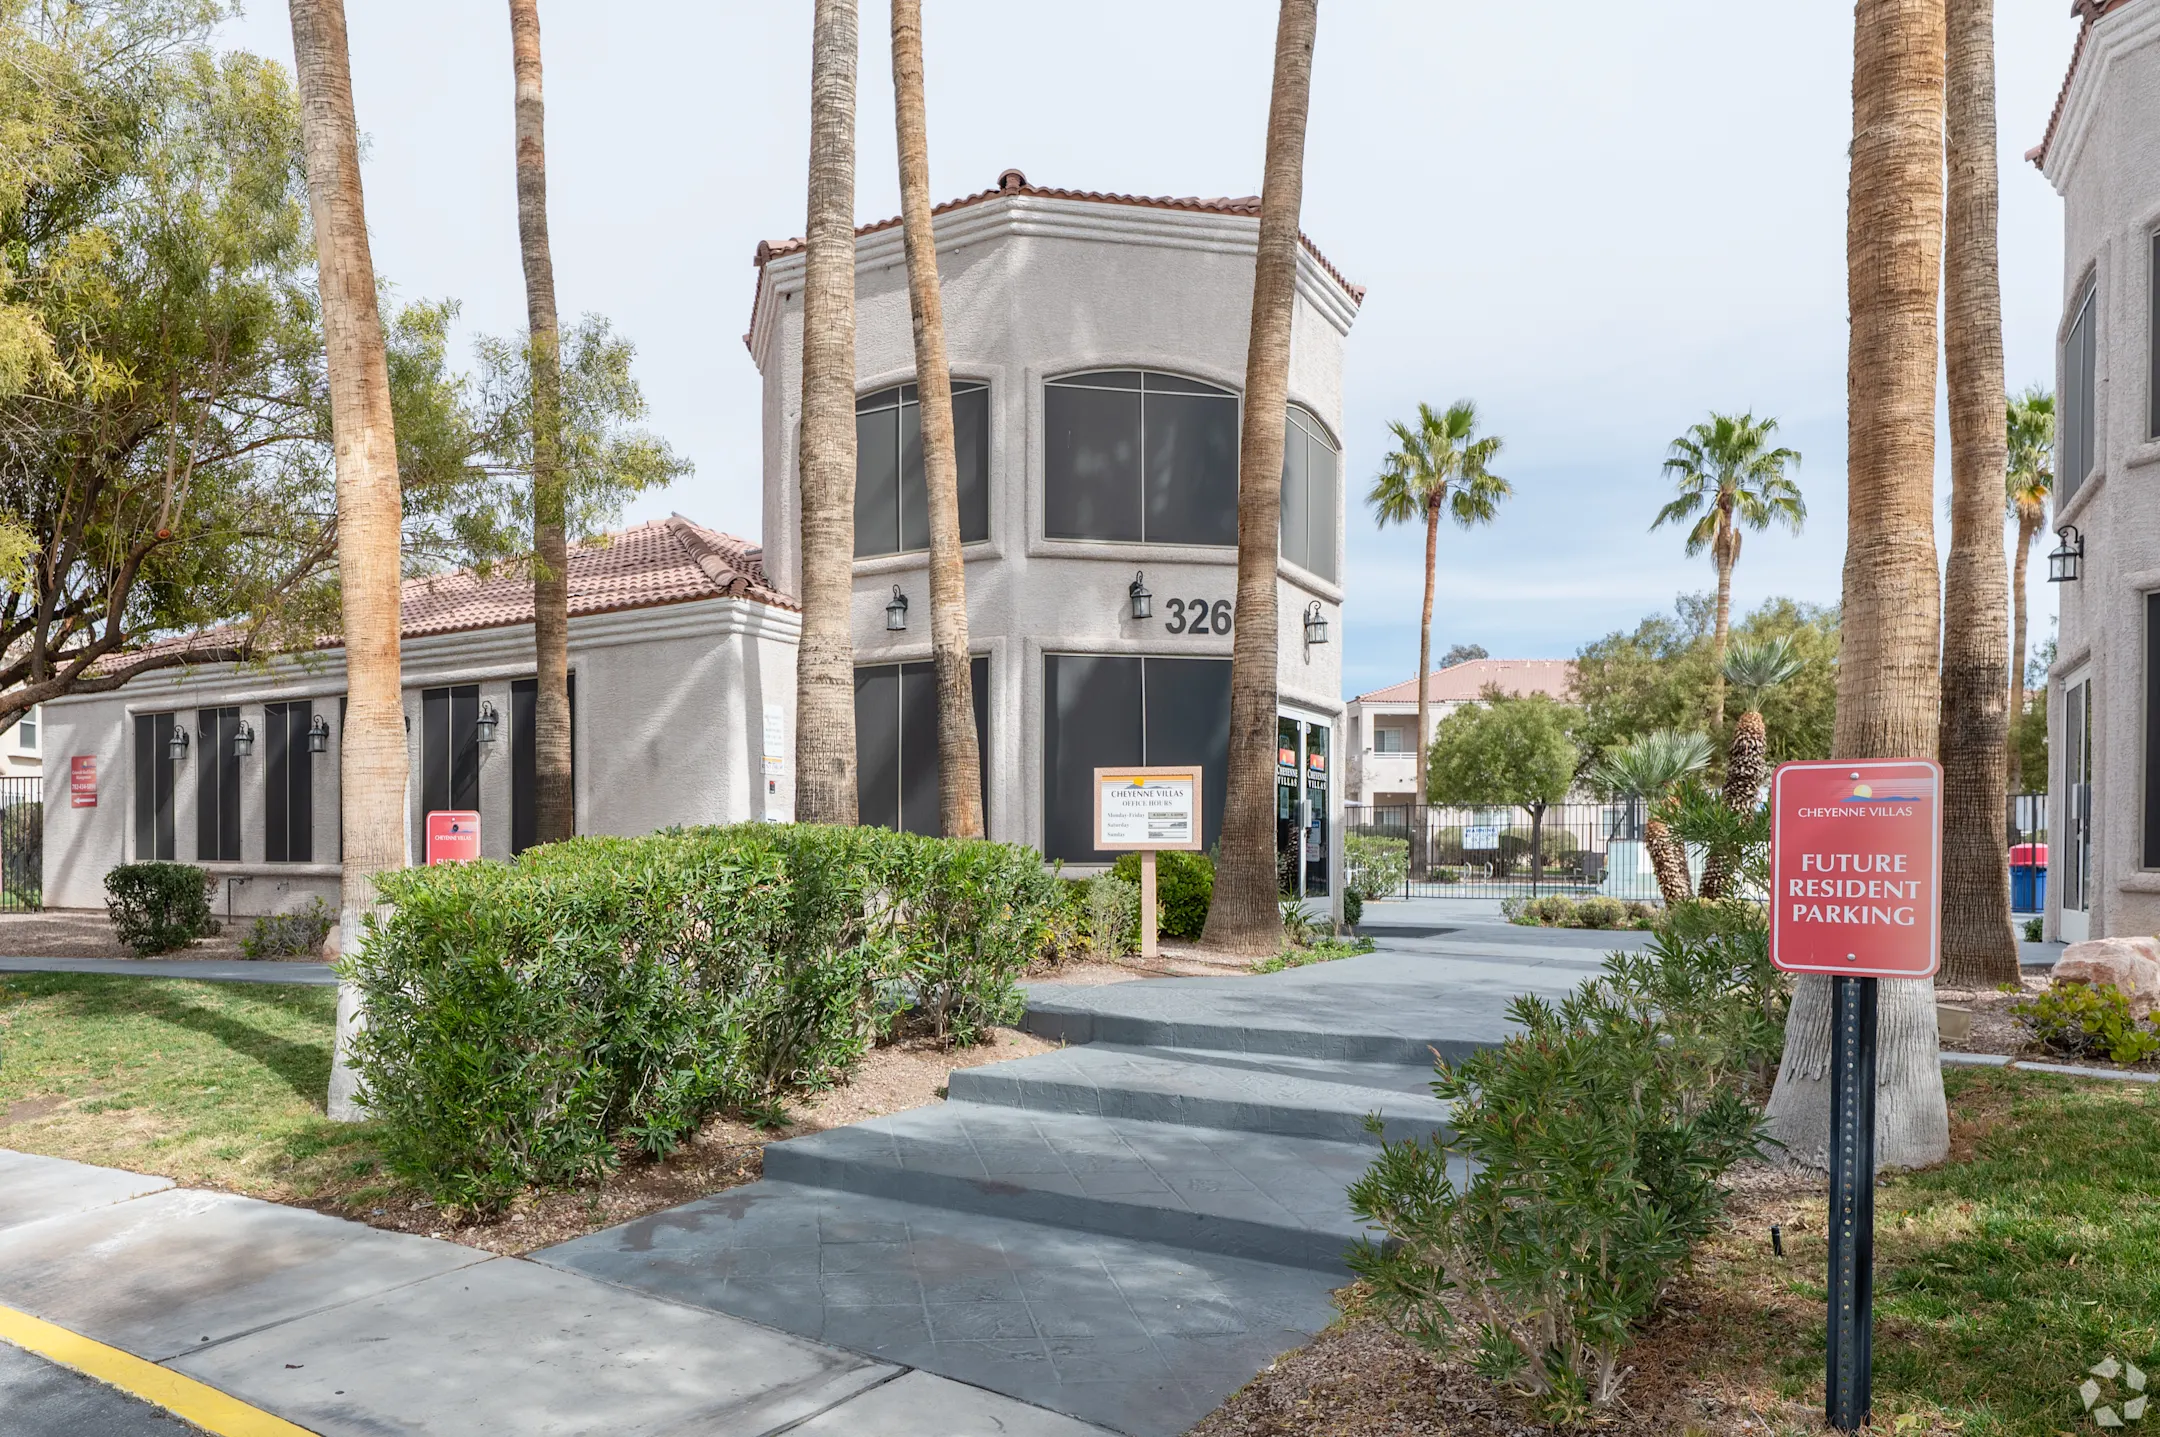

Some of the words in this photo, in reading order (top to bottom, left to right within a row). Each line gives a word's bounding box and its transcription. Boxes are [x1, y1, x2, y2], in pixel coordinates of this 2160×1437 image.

[1165, 598, 1232, 635] 326
[1277, 776, 1298, 787] VILLAS
[1308, 780, 1326, 790] VILLAS
[1111, 790, 1154, 798] CHEYENNE
[1798, 807, 1866, 818] CHEYENNE
[1869, 806, 1913, 817] VILLAS
[1801, 853, 1908, 873] FUTURE
[1789, 878, 1921, 899] RESIDENT
[1792, 904, 1915, 926] PARKING
